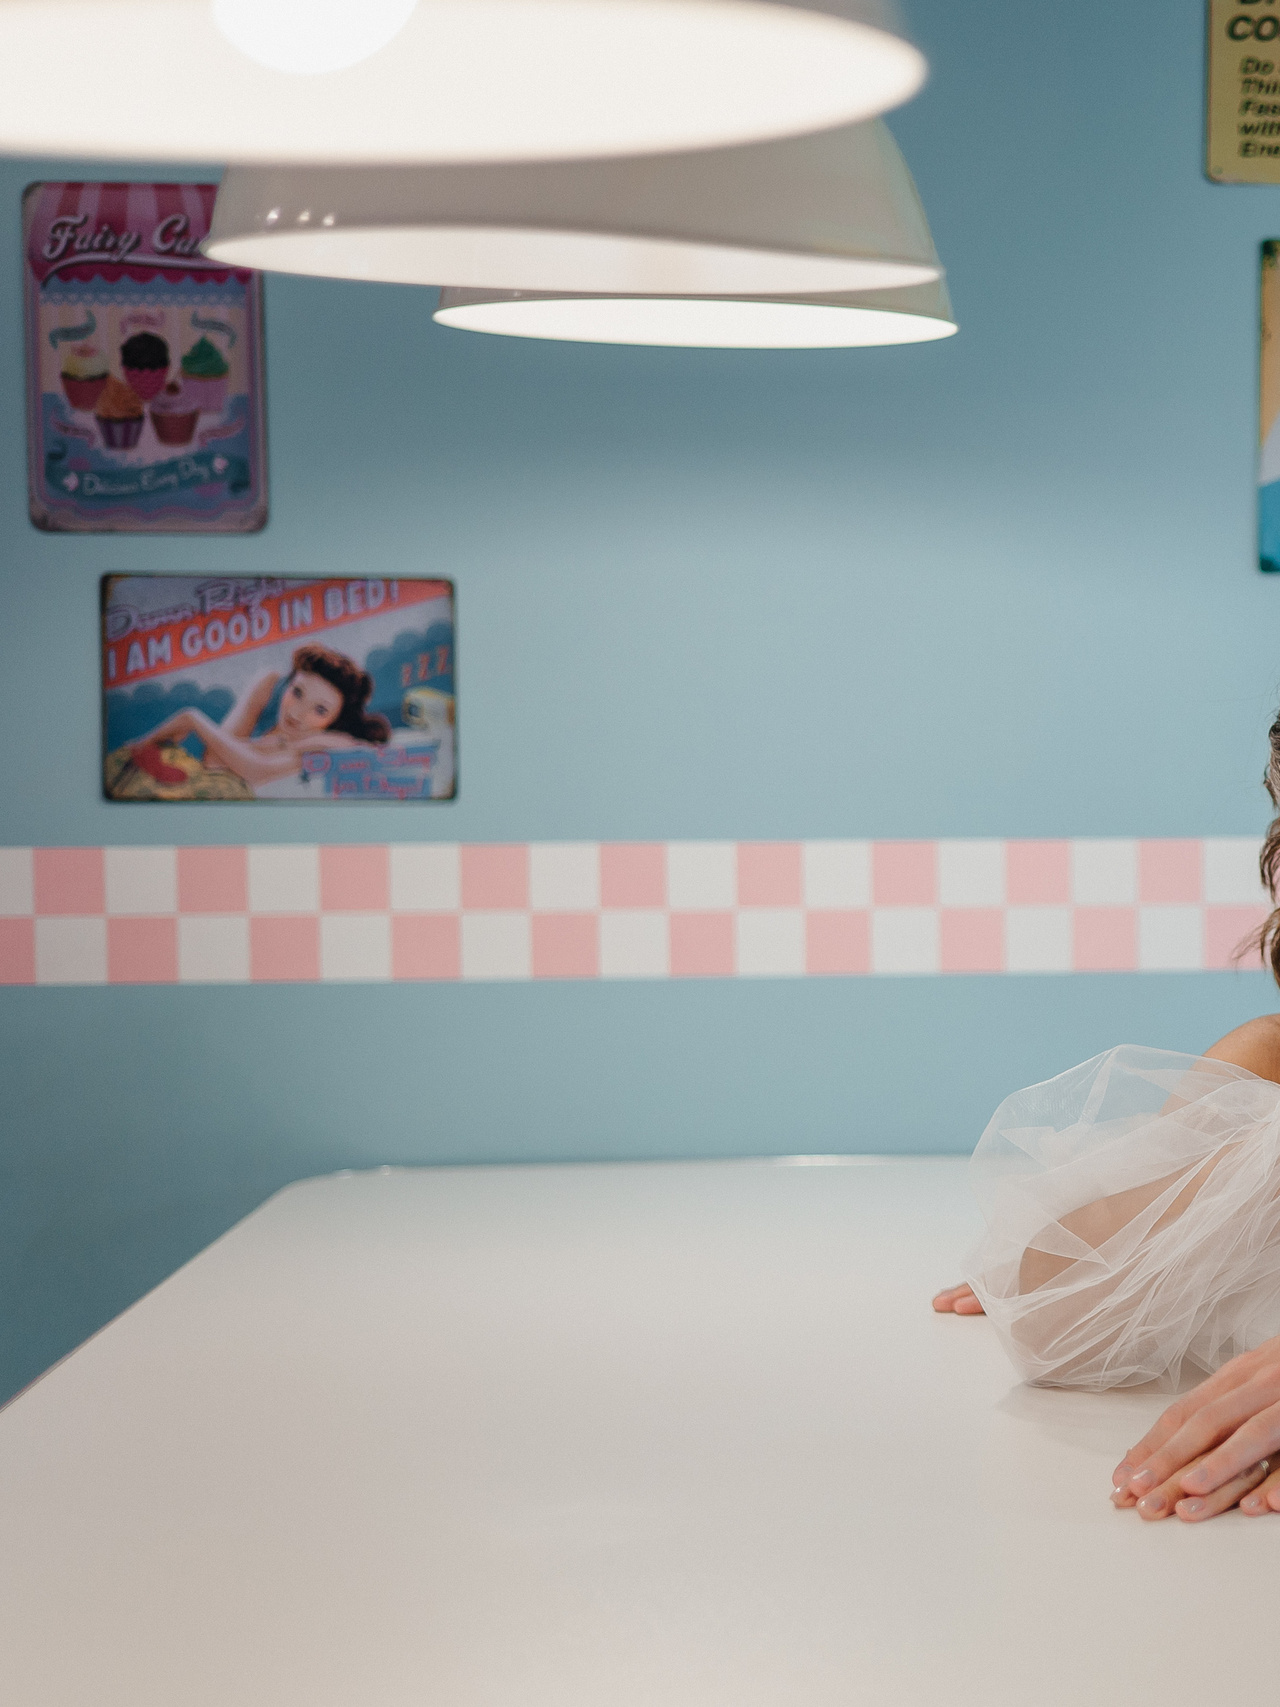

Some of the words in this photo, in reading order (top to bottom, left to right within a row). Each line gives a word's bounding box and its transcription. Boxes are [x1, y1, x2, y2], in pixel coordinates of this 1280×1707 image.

[1240, 56, 1274, 75] Do
[42, 213, 141, 263] Fairy
[108, 647, 116, 679] I
[125, 633, 172, 674] AM
[181, 611, 271, 657] GOOD
[279, 594, 313, 632] IN
[323, 579, 399, 621] BED!
